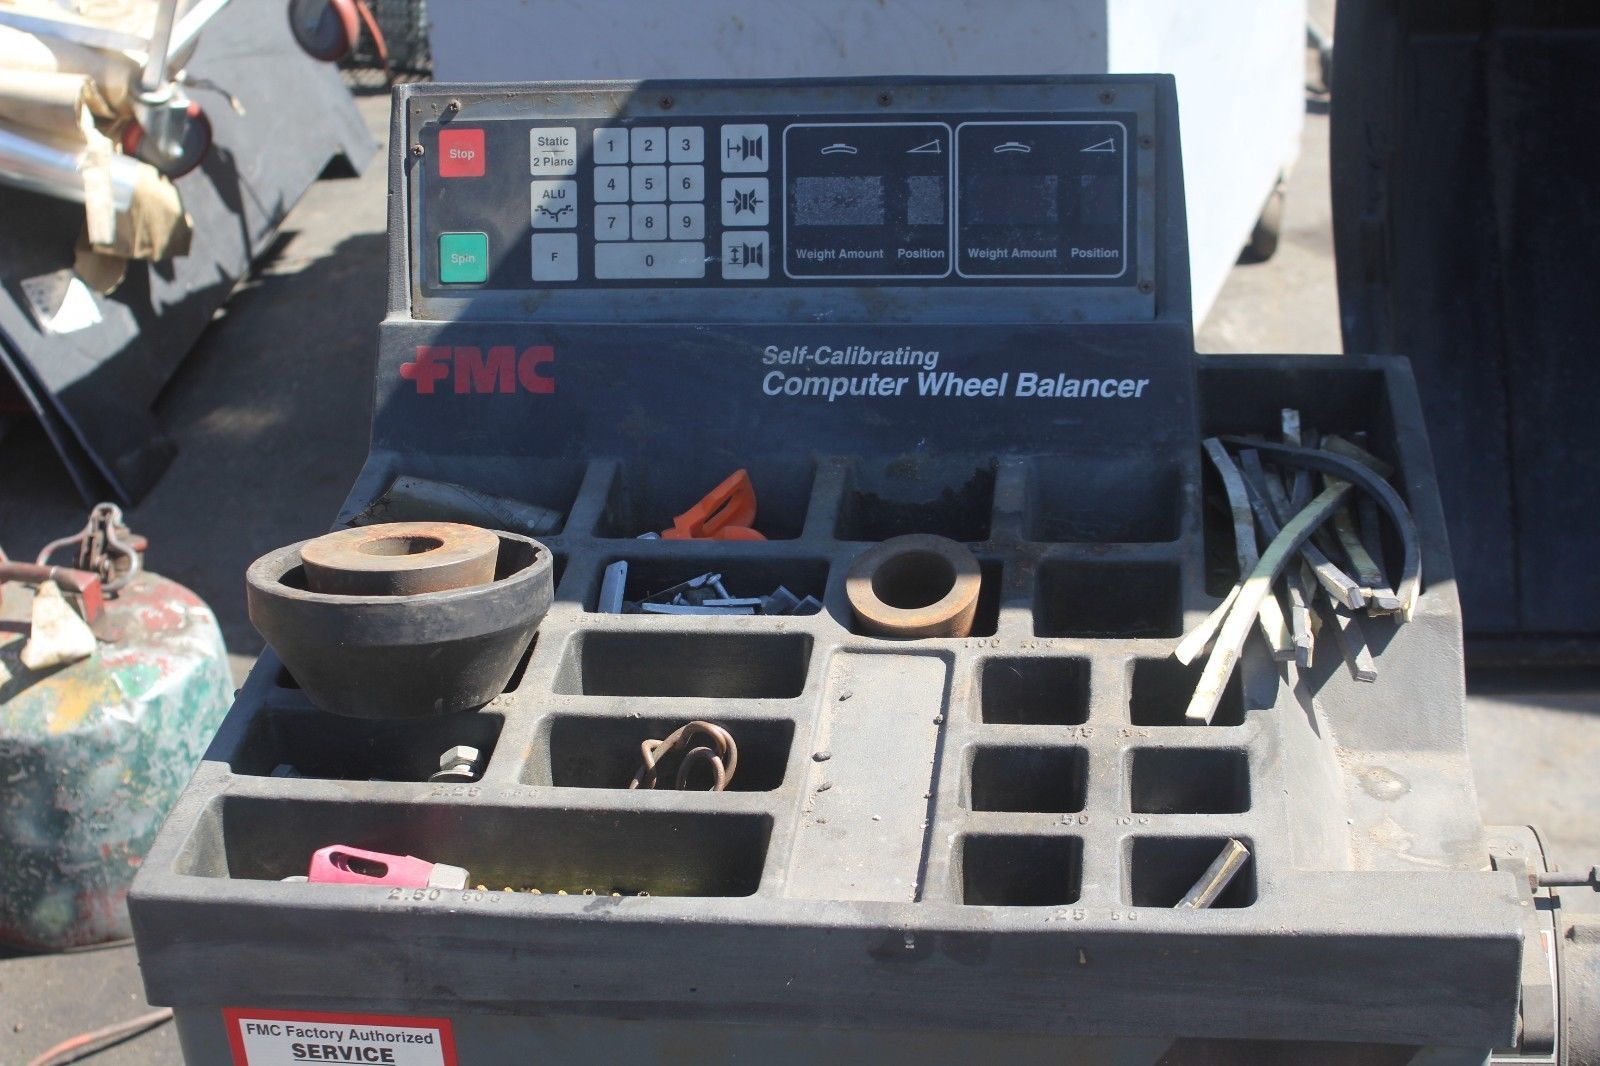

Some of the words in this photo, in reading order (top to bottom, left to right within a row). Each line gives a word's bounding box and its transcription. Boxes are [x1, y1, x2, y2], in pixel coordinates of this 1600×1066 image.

[537, 135, 569, 147] Static
[607, 140, 614, 152] 1
[644, 140, 653, 152] 2
[682, 139, 691, 151] 3
[449, 148, 475, 161] Stop
[533, 157, 540, 167] 2
[543, 156, 574, 167] Plane
[606, 178, 616, 190] 4
[644, 178, 653, 190] 5
[682, 177, 691, 189] 6
[542, 189, 566, 200] ALU
[608, 217, 616, 229] 7
[645, 217, 653, 229] 8
[683, 216, 691, 228] 9
[451, 252, 476, 266] Spin
[551, 252, 558, 262] F
[796, 248, 836, 261] Weight
[839, 248, 884, 260] Amount
[897, 248, 945, 260] Position
[968, 247, 1009, 261] Weight
[1011, 247, 1057, 259] Amount
[1071, 247, 1119, 259] Position
[645, 255, 653, 267] 0
[762, 345, 940, 370] Self-Calibrating
[400, 345, 555, 394] FMC
[762, 371, 908, 402] Computer
[917, 372, 1008, 397] Wheel
[1015, 372, 1149, 398] Balancer
[387, 886, 440, 901] 2.50
[246, 1022, 281, 1037] FMC
[287, 1025, 344, 1042] Factory
[349, 1028, 433, 1045] Authorized
[291, 1042, 395, 1063] SERVICE
